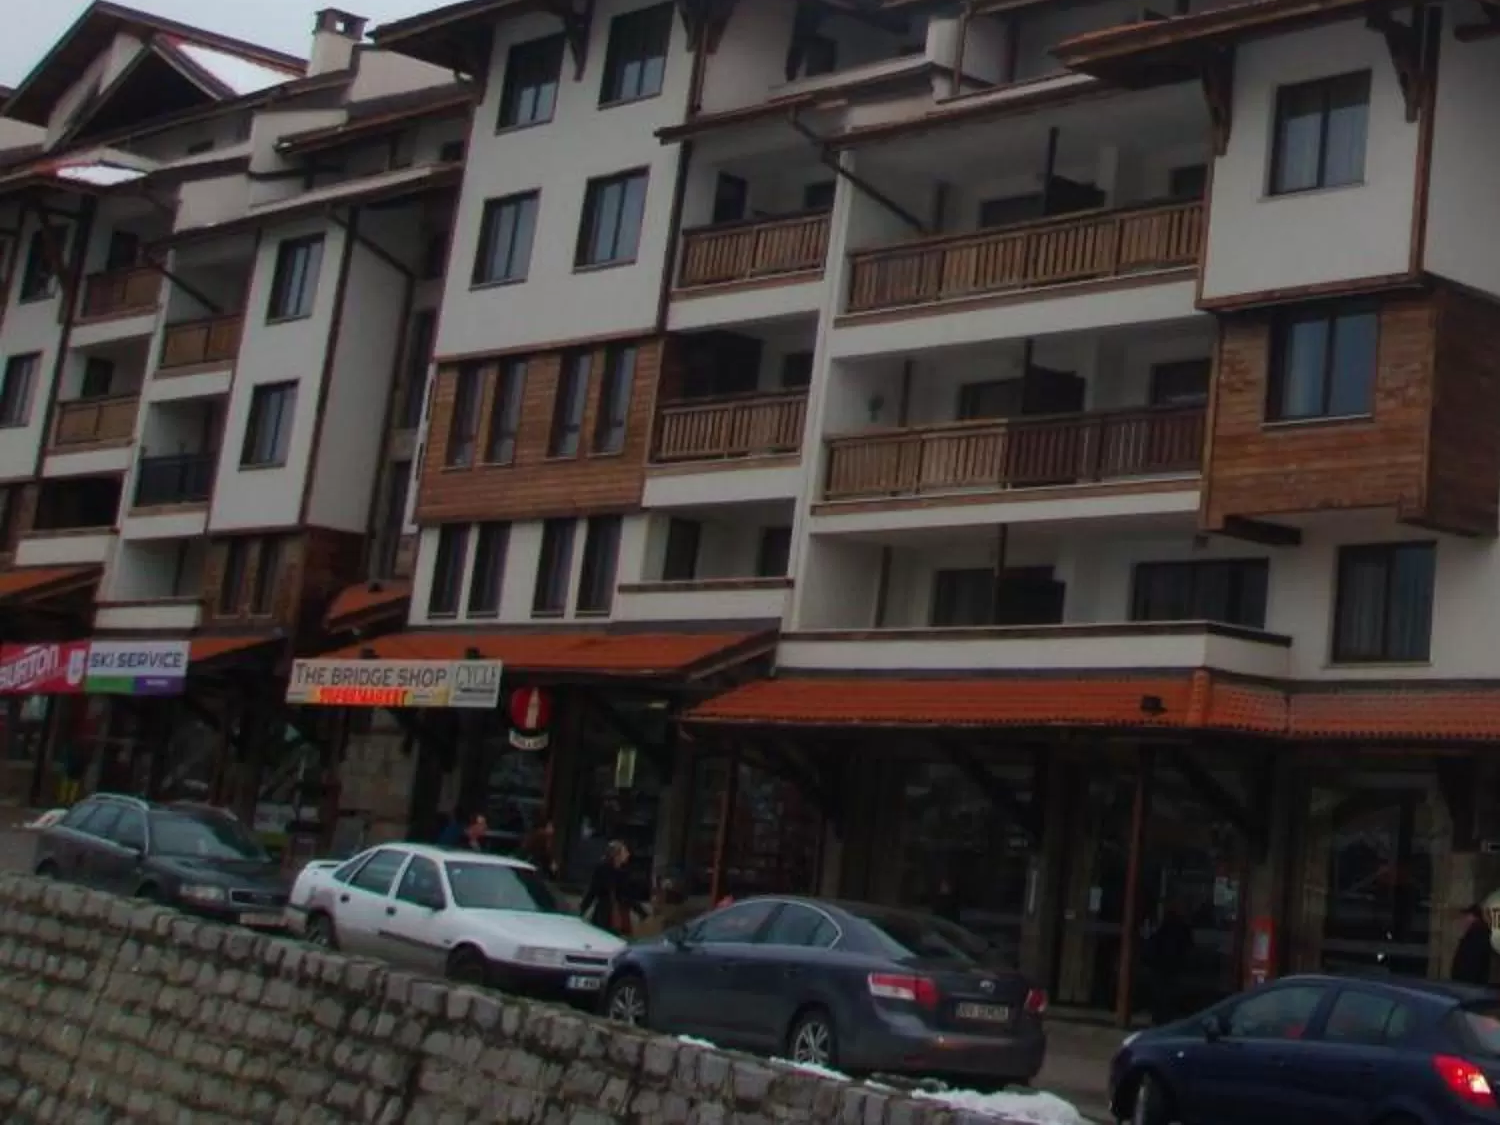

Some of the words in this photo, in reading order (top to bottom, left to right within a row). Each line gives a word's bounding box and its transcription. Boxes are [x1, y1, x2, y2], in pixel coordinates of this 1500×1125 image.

[90, 651, 114, 668] SKI
[117, 651, 184, 668] SERVICE
[296, 662, 325, 685] THE
[331, 665, 394, 686] BRIDGE
[399, 667, 448, 688] SHOP
